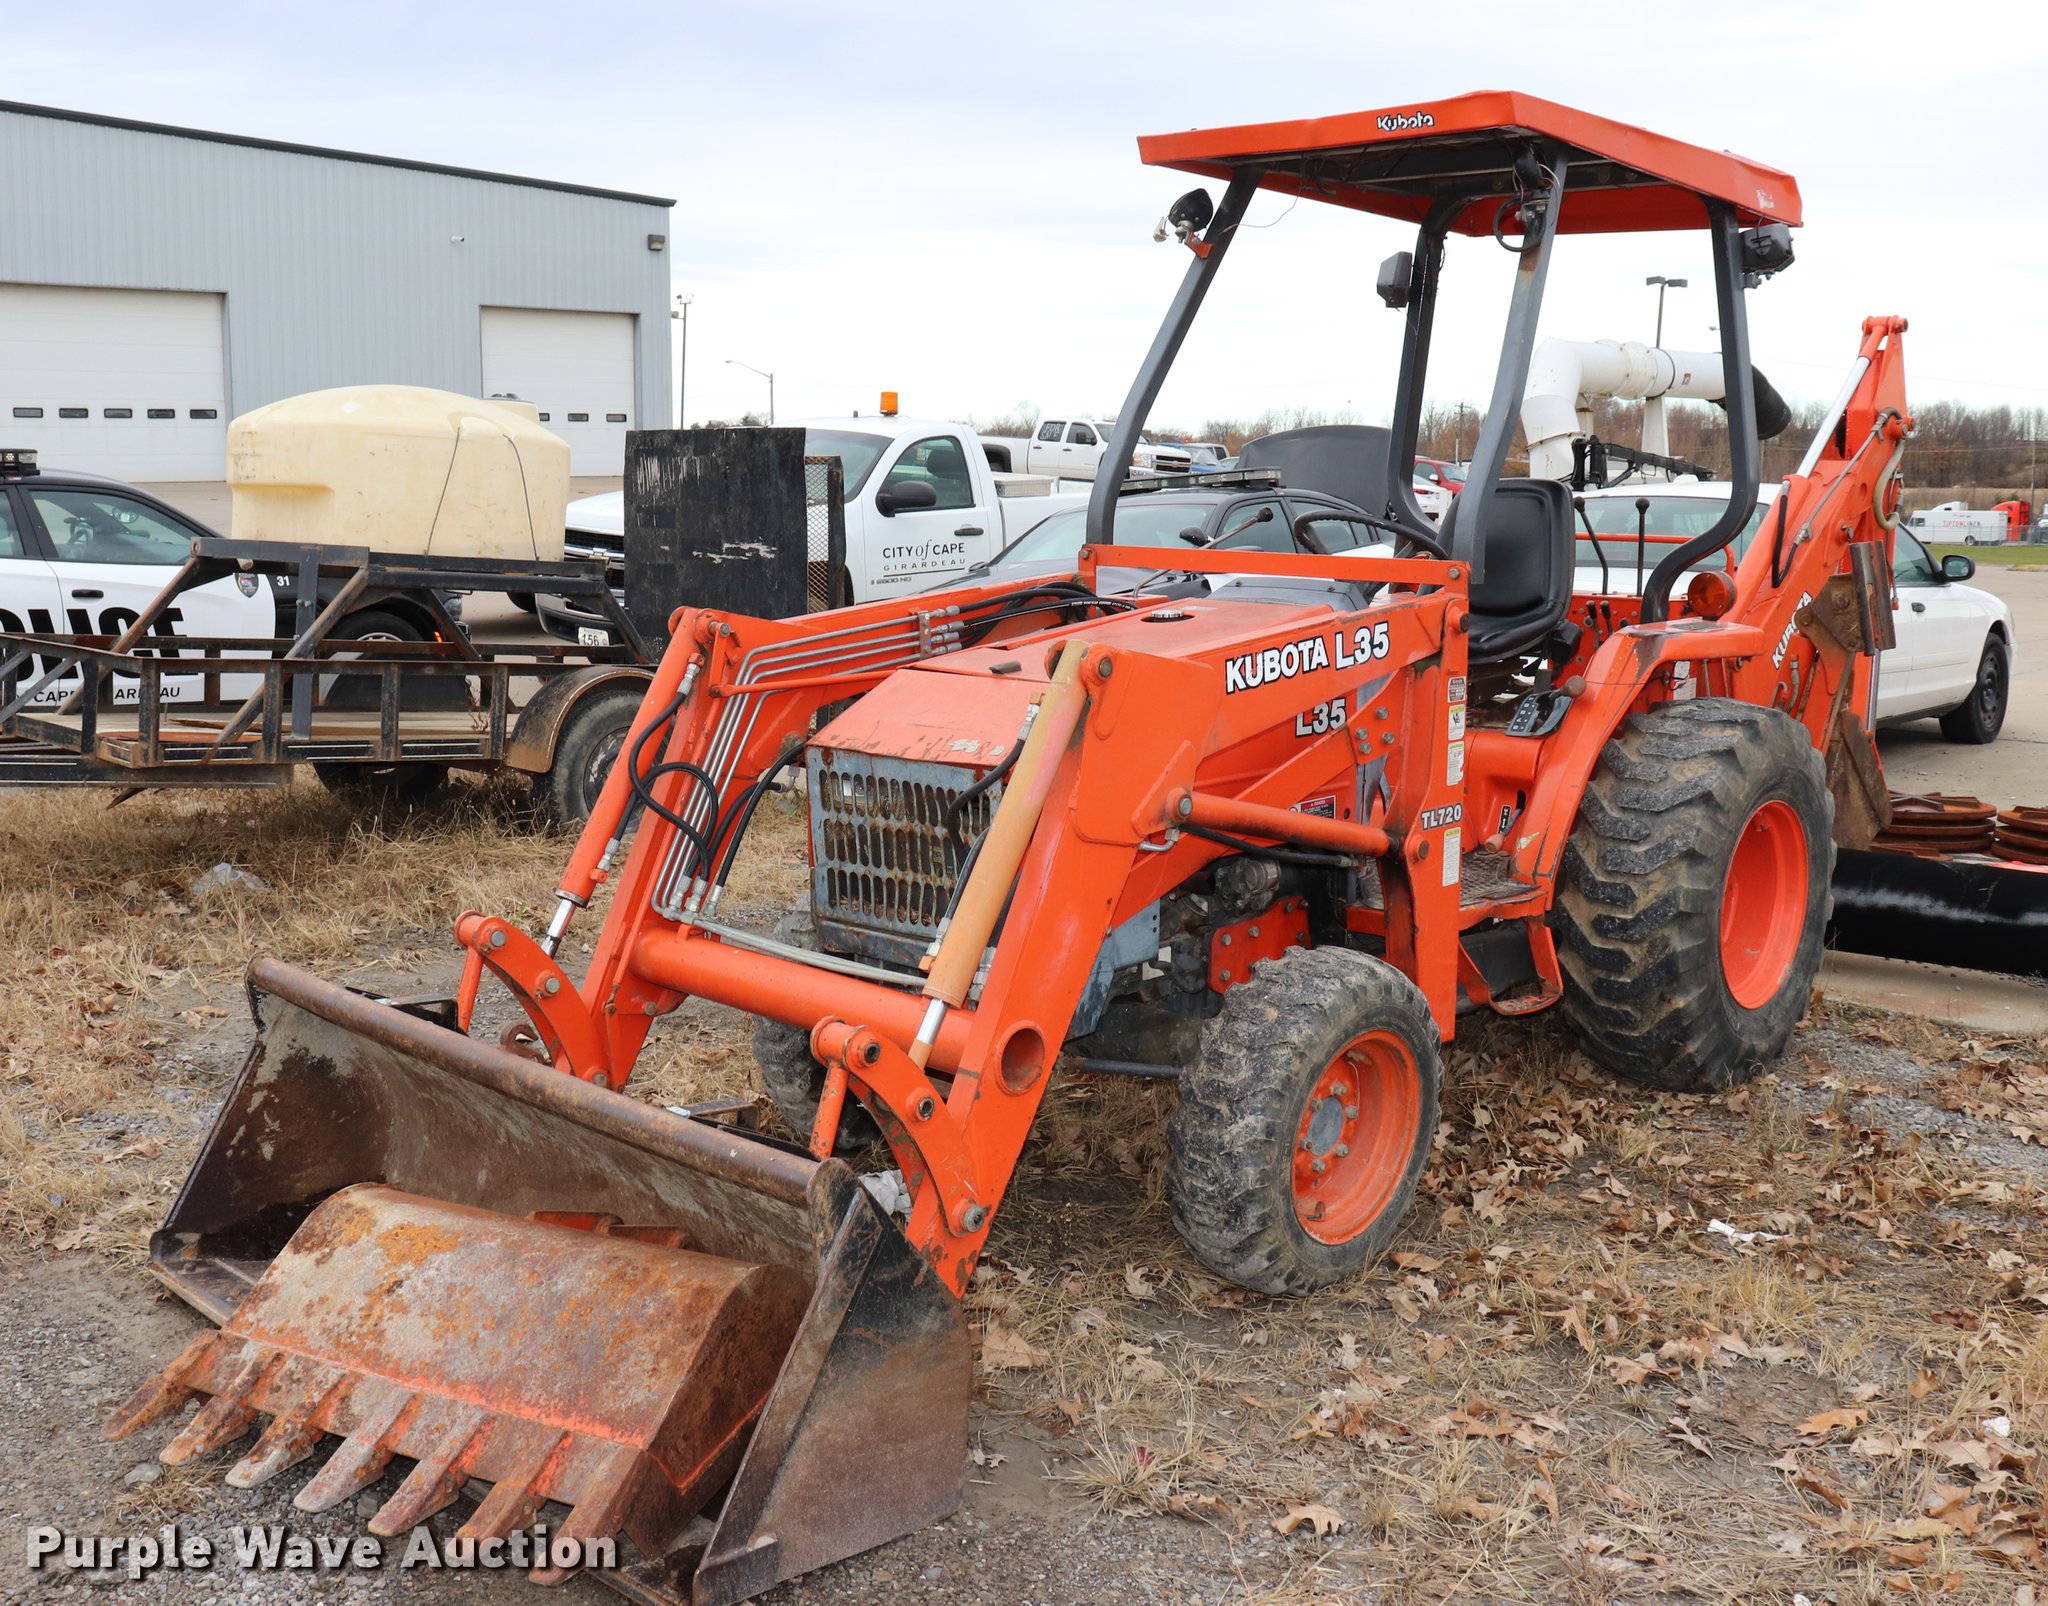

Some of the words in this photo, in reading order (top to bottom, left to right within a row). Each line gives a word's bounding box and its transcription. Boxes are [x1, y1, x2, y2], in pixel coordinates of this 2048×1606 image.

[1377, 111, 1434, 131] Kubota
[882, 546, 913, 559] CITY
[915, 539, 932, 560] of
[932, 542, 965, 556] CAPE
[883, 558, 965, 571] GIRARDEAU
[276, 575, 290, 587] 31
[1226, 635, 1330, 695] KUBOTA
[1335, 621, 1390, 670] L35
[34, 689, 76, 703] CAP
[1295, 697, 1347, 738] L35
[1421, 802, 1463, 831] TL720
